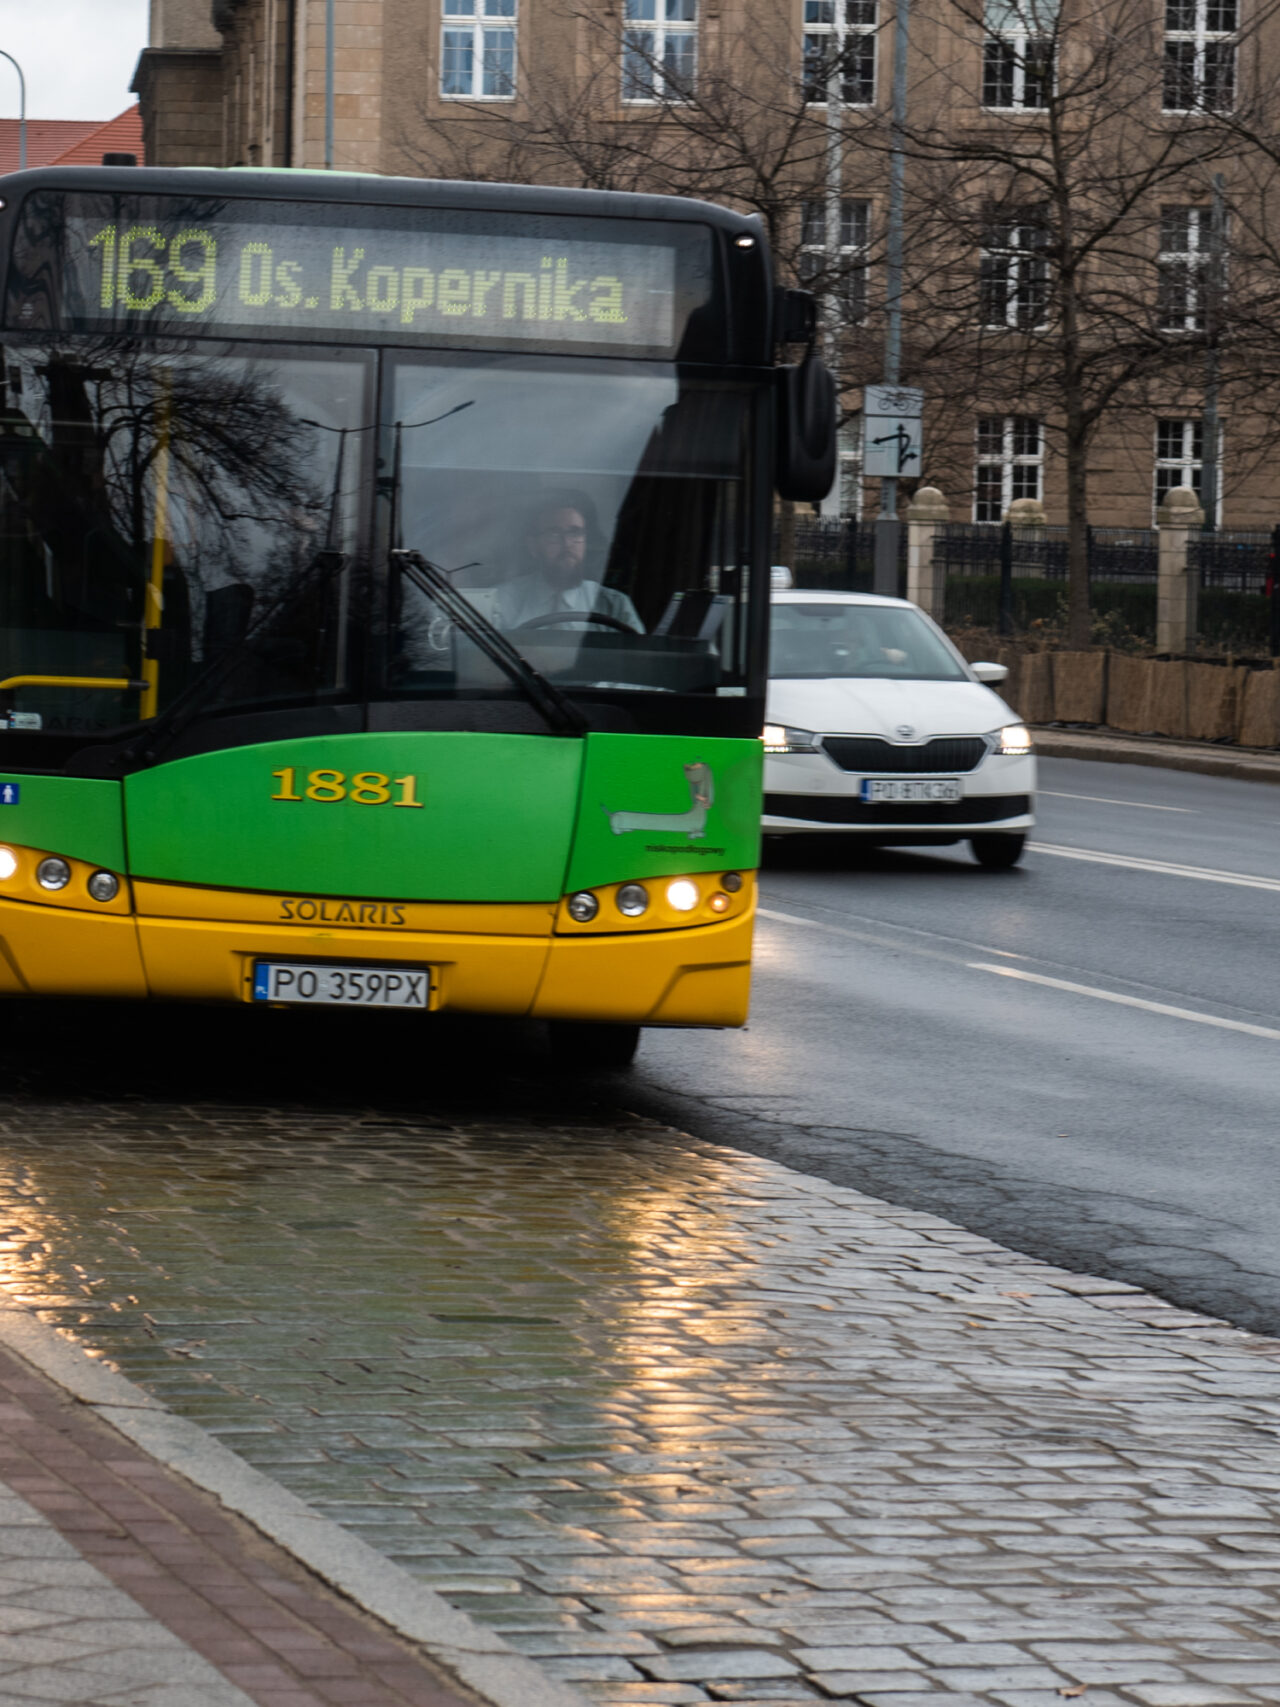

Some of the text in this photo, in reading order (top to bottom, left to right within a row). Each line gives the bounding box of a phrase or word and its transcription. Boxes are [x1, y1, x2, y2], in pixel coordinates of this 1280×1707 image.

[88, 224, 629, 323] 169 Os. Kopernika
[270, 767, 424, 808] 1881
[279, 899, 406, 926] SOLARIS
[274, 968, 318, 999] PO
[328, 971, 424, 1005] 359PX
